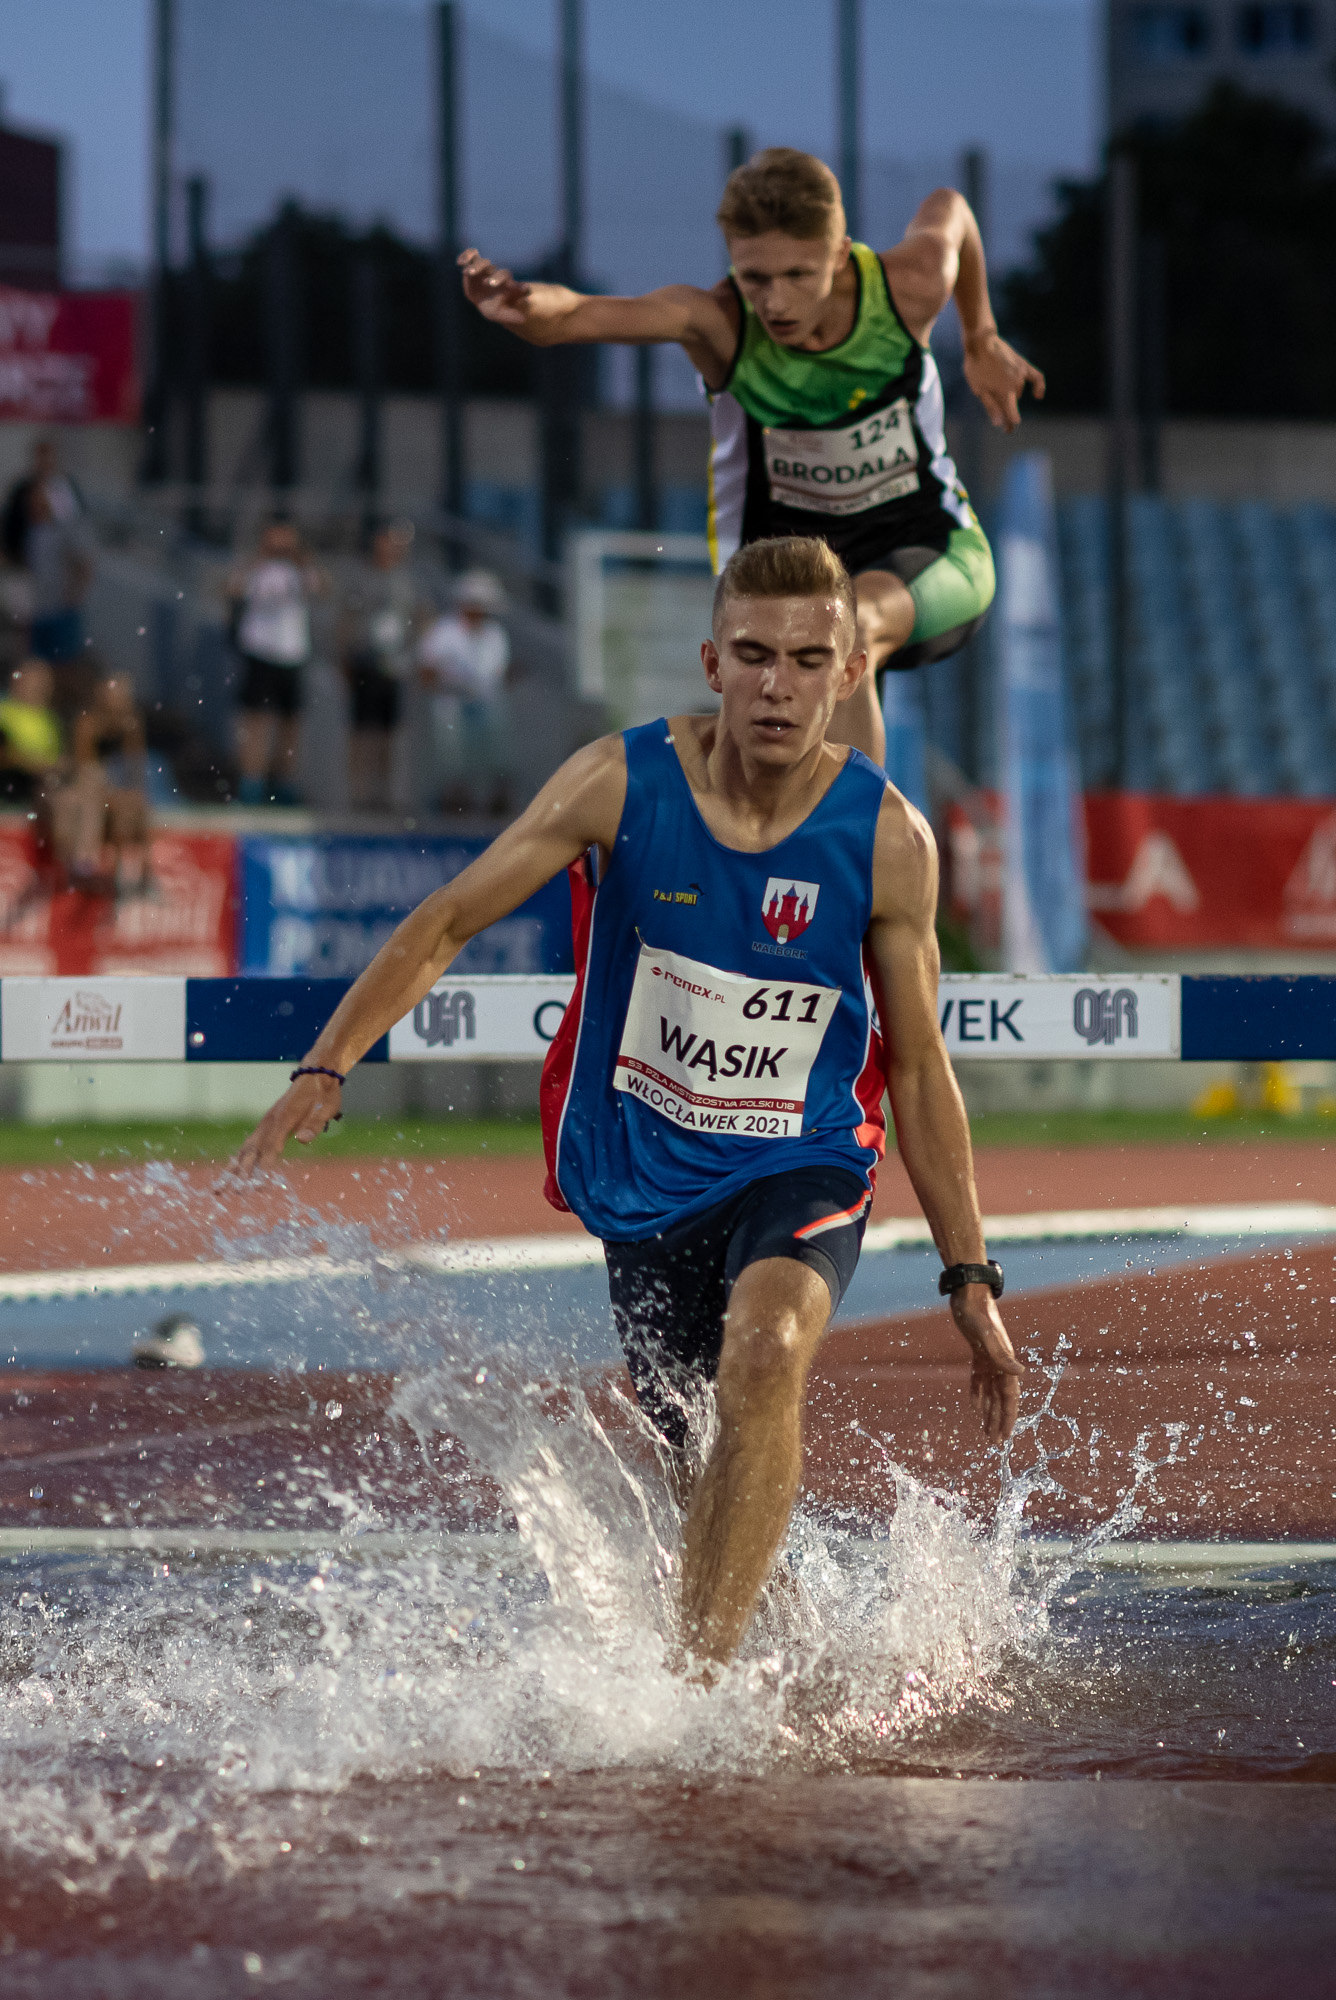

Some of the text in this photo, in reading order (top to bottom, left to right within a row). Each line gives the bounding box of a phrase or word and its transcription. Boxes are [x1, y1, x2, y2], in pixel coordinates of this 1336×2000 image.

[851, 409, 900, 450] 124
[675, 891, 698, 906] SPORT
[752, 941, 809, 960] MALBORK
[742, 987, 822, 1024] 611
[660, 1015, 789, 1082] WĄSIK
[627, 1074, 789, 1136] WŁOCŁAWEK 2021
[645, 1067, 668, 1086] PZLA
[669, 1082, 738, 1107] MISTRZOSTWA
[740, 1100, 774, 1108] POLSKI
[776, 1102, 795, 1110] U18
